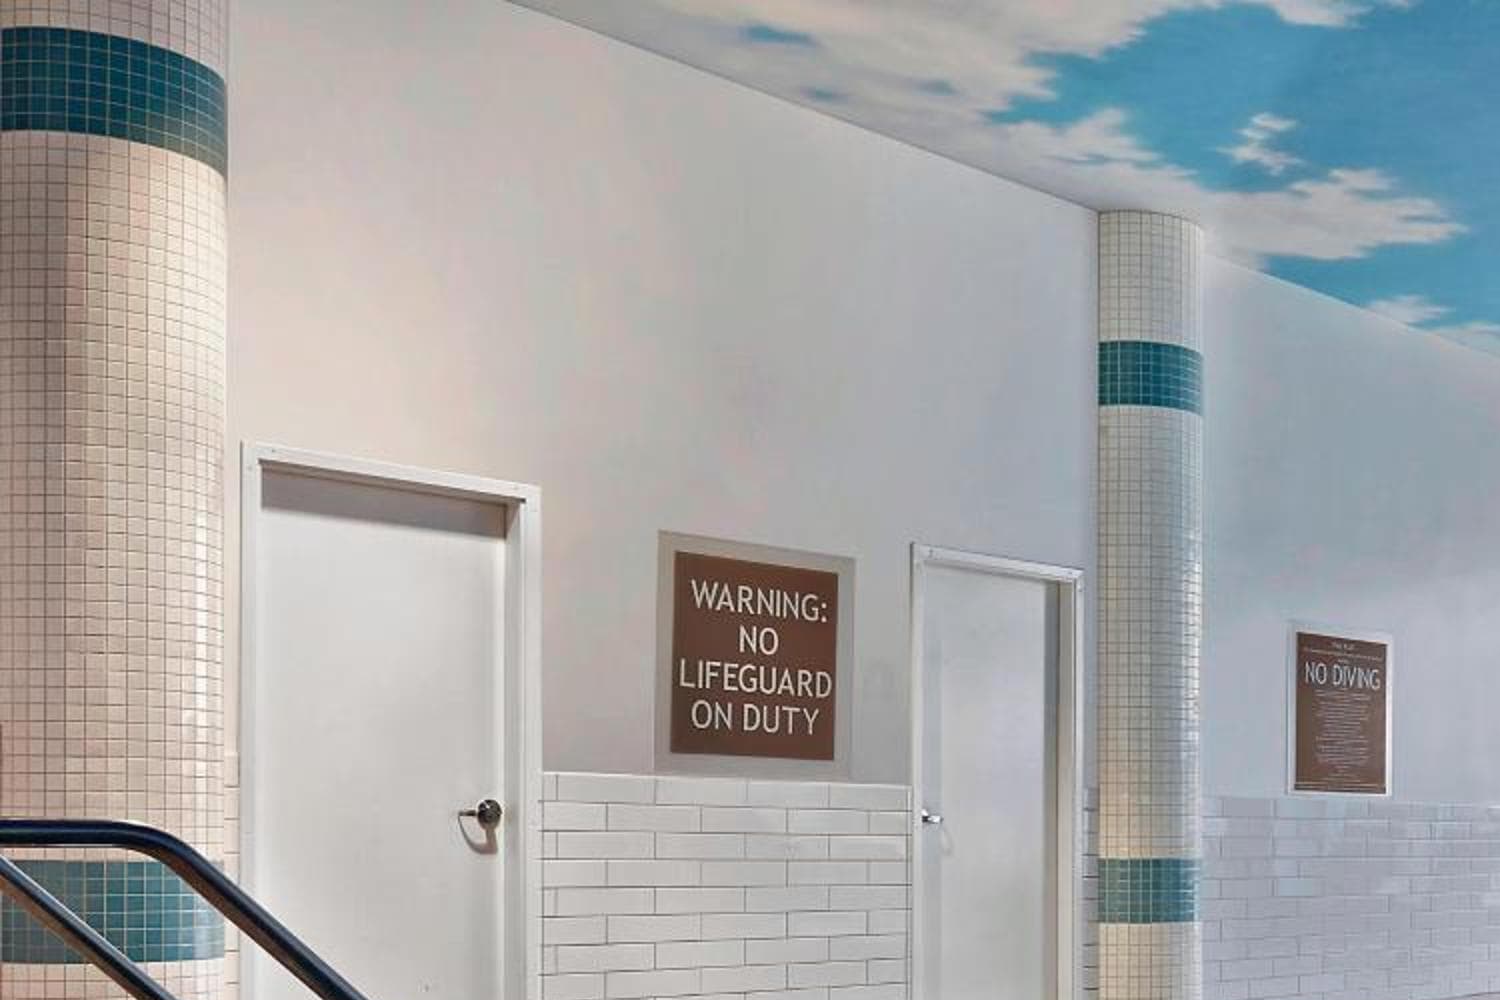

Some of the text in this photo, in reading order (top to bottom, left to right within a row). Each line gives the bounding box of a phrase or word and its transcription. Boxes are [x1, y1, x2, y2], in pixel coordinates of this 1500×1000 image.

[691, 579, 828, 623] WARNING:
[738, 625, 779, 655] NO
[679, 658, 832, 698] LIFEGUARD
[1305, 661, 1381, 690] NO DIVING
[691, 700, 820, 735] ON DUTY
